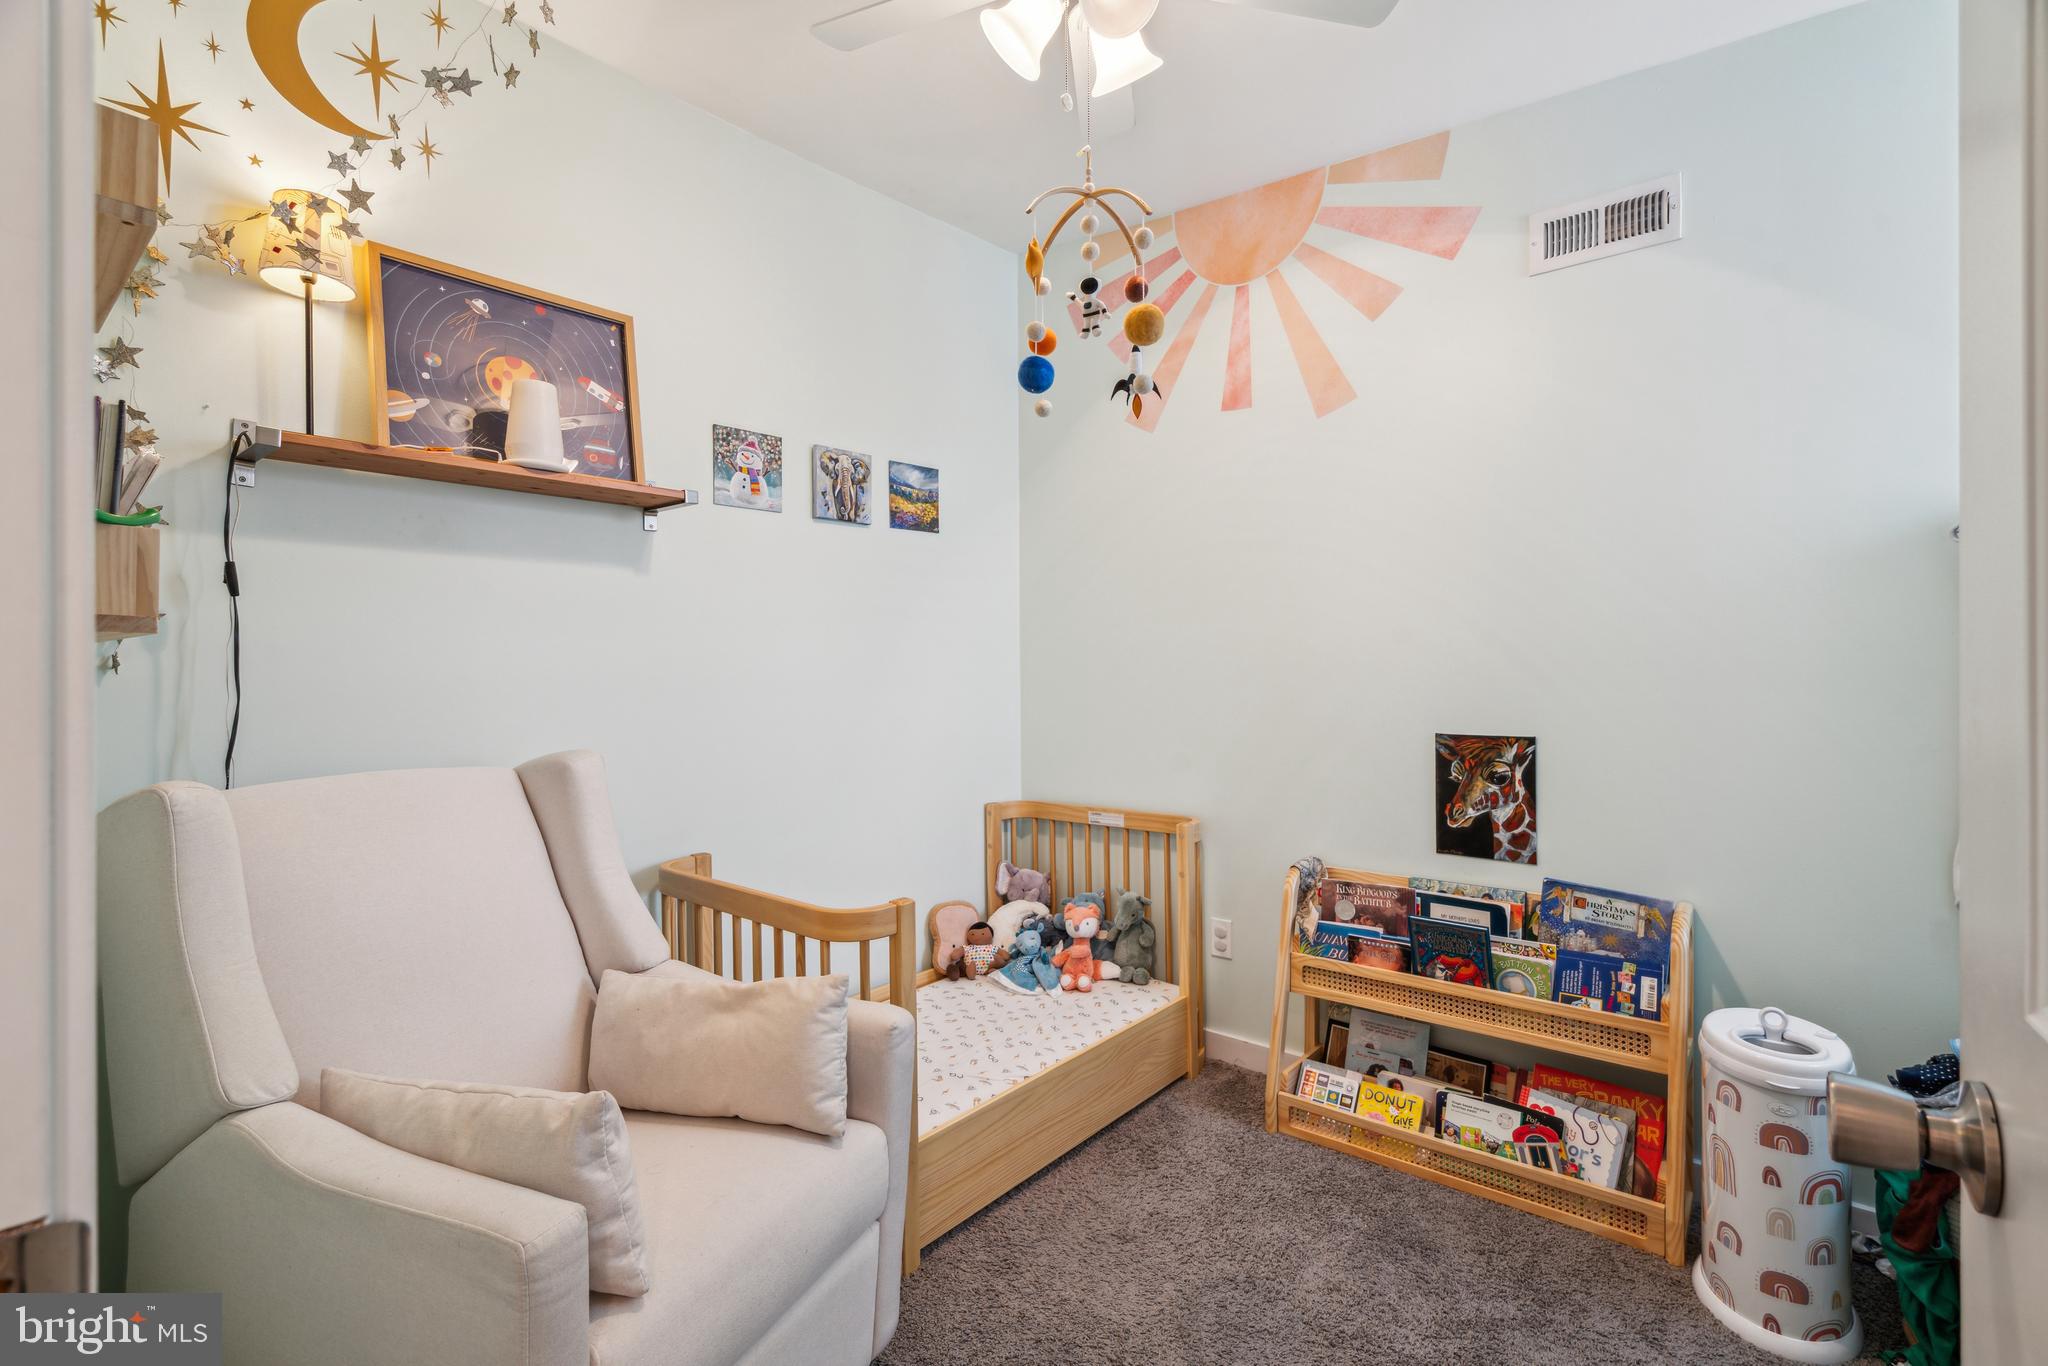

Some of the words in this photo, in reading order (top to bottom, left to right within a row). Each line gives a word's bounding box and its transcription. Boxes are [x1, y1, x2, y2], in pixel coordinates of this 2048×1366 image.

[1336, 884, 1355, 894] KING
[1354, 895, 1392, 908] BATHTUB
[1591, 910, 1625, 921] STORY
[1307, 931, 1349, 946] UNAW
[1328, 948, 1348, 960] BU
[1499, 959, 1534, 975] BUTTON
[1540, 1073, 1562, 1087] THE
[1564, 1077, 1596, 1091] VERY
[1364, 1088, 1417, 1112] DONUT
[1392, 1115, 1414, 1127] GIVE
[1636, 1123, 1661, 1146] AR
[1567, 1144, 1602, 1166] or's
